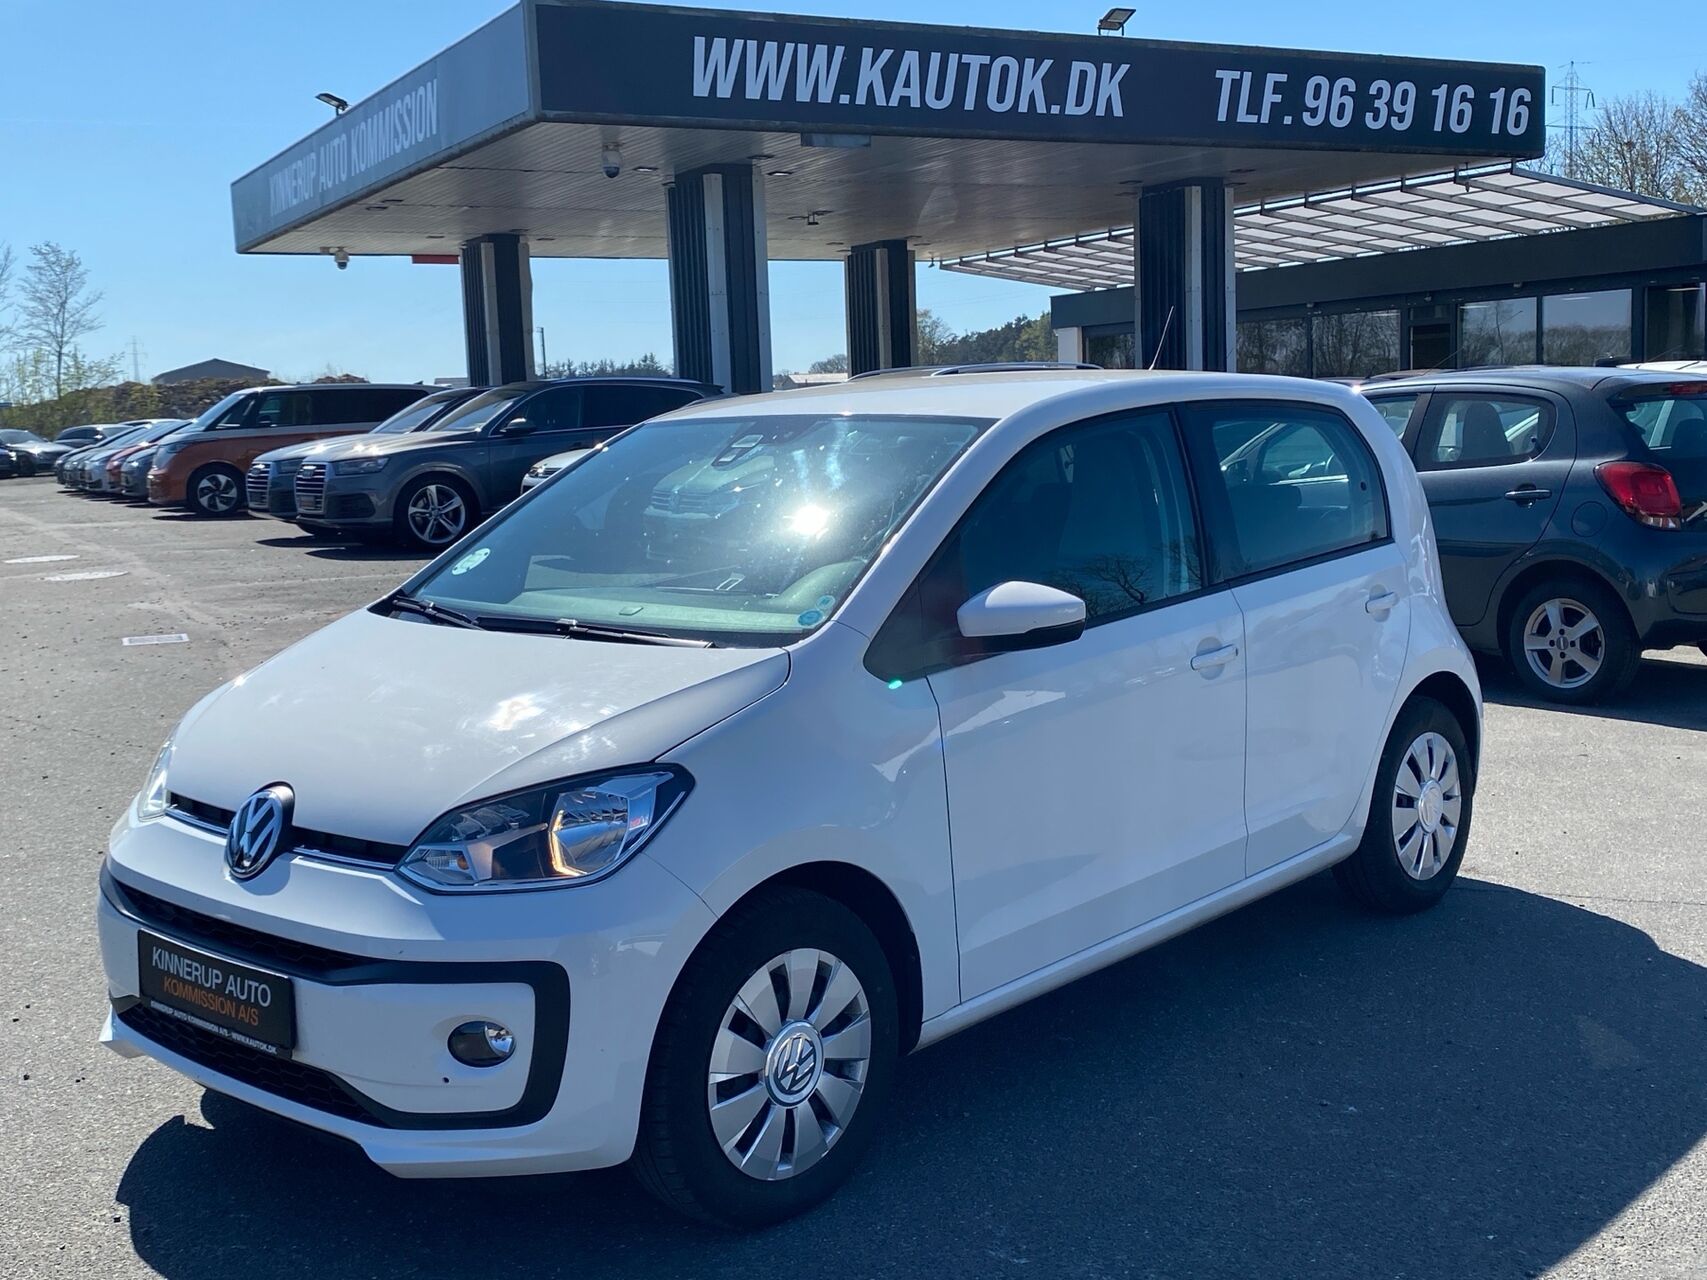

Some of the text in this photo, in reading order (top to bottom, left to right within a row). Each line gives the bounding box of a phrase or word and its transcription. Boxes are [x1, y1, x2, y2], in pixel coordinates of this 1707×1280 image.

[692, 36, 1131, 117] WWW.KAUTOK.DK
[1215, 69, 1532, 136] TLF. 96 39 16 16
[268, 78, 438, 217] KINNERUP AUTO KOMMISSION
[152, 946, 272, 1007] KINNERUP AUTO
[163, 976, 259, 1026] KOMMISSION A/S
